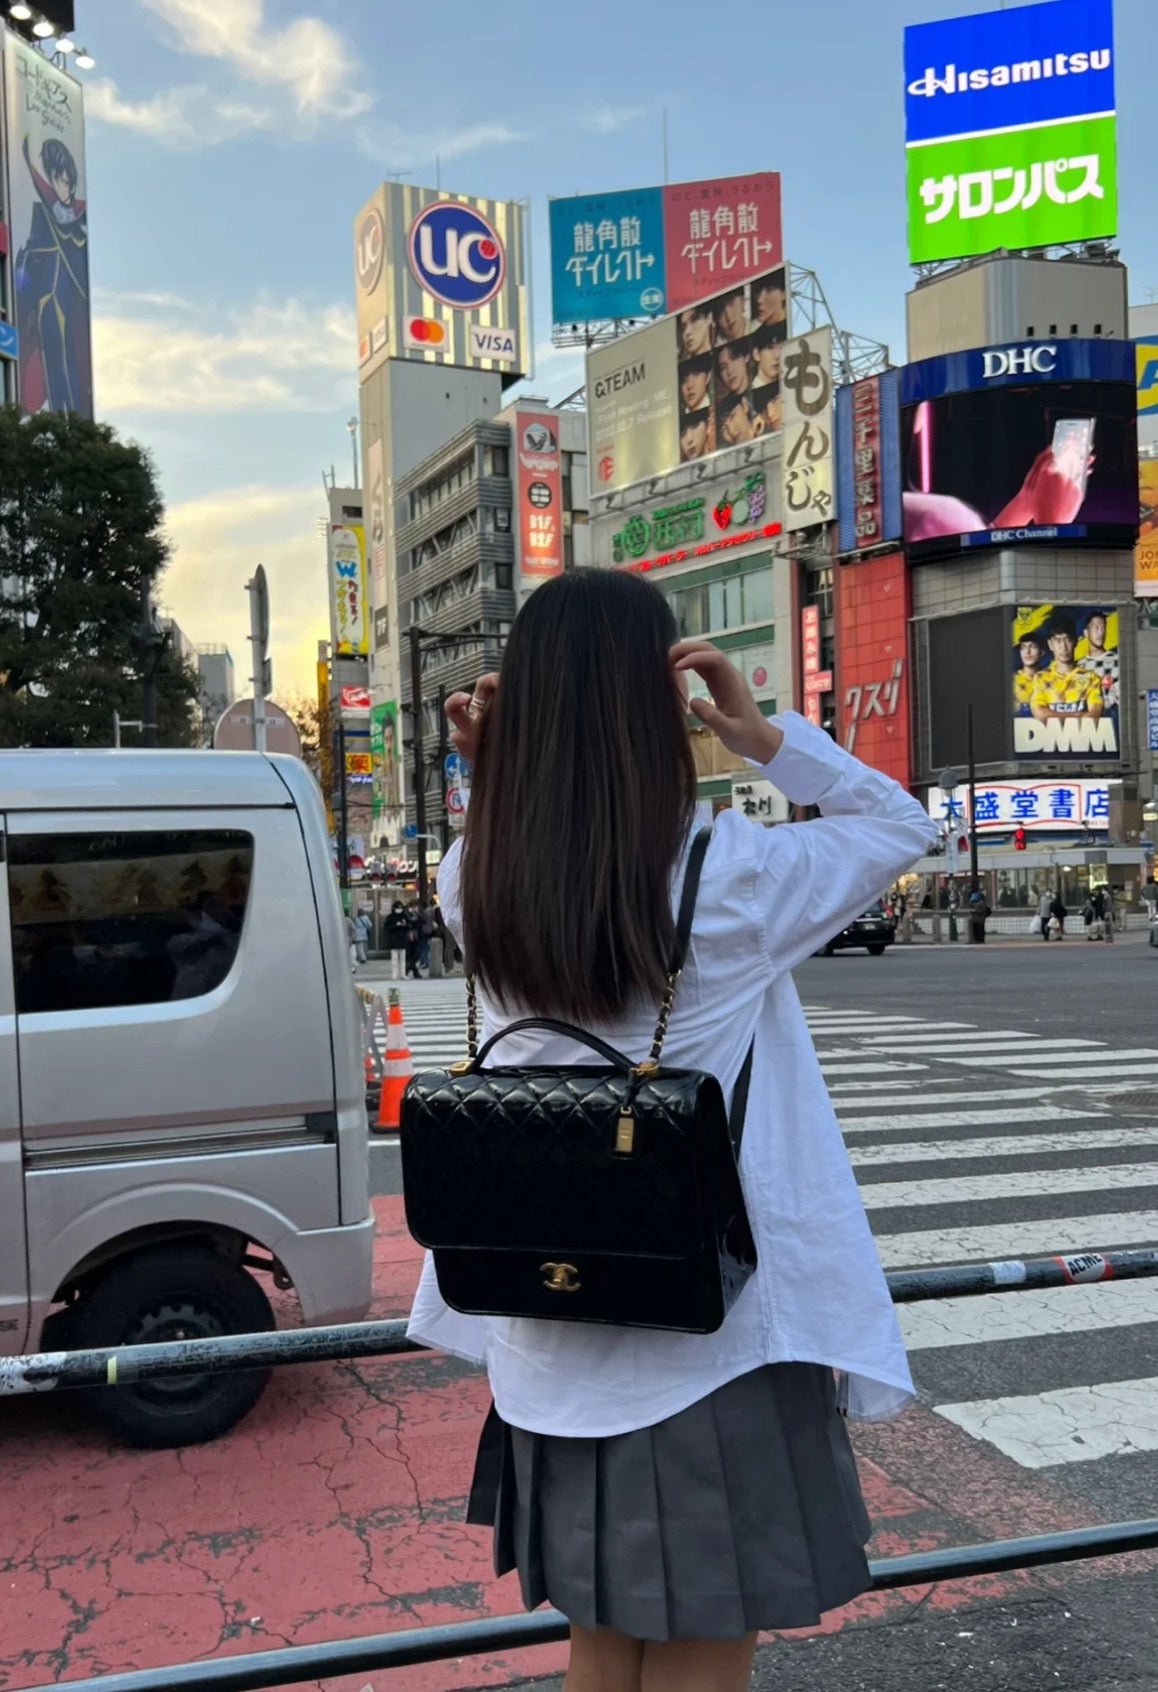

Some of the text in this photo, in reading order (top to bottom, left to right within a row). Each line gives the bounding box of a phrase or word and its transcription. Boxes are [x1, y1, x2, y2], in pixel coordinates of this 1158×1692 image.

[907, 48, 1111, 97] Hisamitsu
[919, 154, 1104, 224] サロンパス
[573, 216, 642, 254] 龍角散
[690, 203, 759, 240] 龍角散
[565, 250, 656, 288] ダイレクト
[681, 236, 774, 274] ダイレクト
[474, 332, 515, 354] VISA
[594, 362, 646, 399] &TEAM
[982, 345, 1057, 379] DHC
[783, 337, 832, 518] もんじゃ
[990, 526, 1058, 542] DHC Channel
[844, 657, 904, 754] クスリ
[1013, 717, 1118, 753] DMM
[940, 788, 1110, 820] 大盛堂書店
